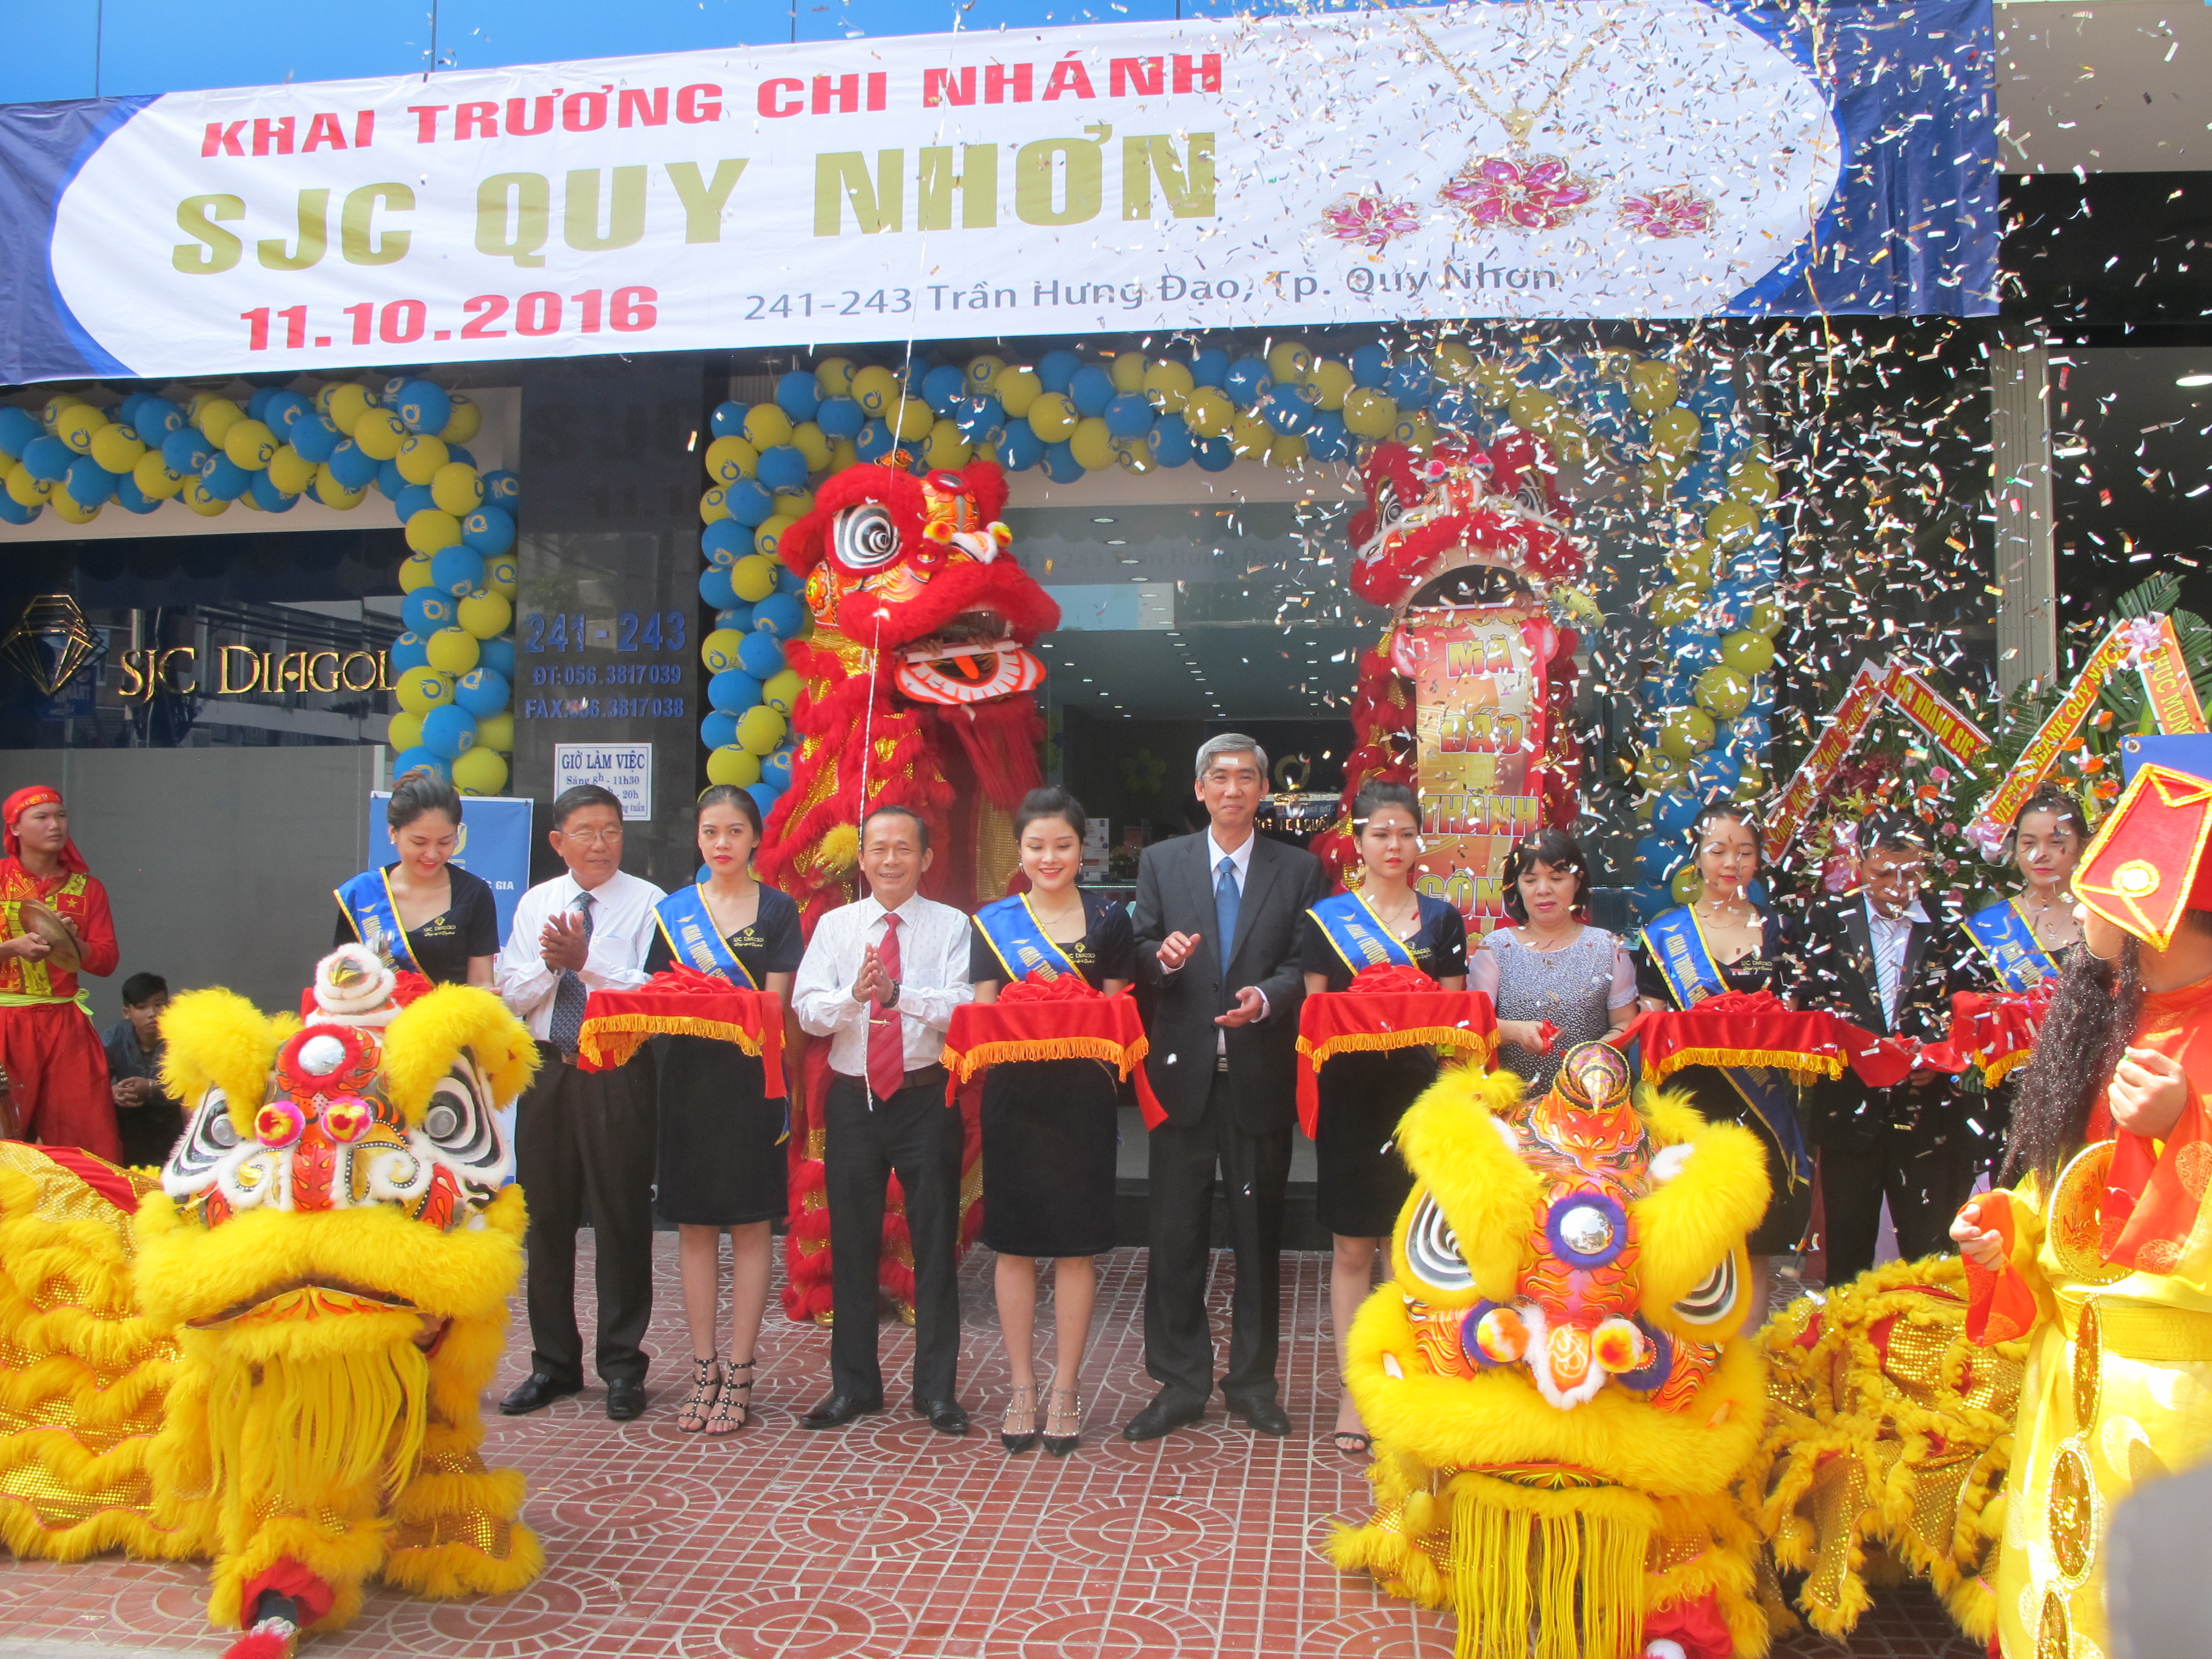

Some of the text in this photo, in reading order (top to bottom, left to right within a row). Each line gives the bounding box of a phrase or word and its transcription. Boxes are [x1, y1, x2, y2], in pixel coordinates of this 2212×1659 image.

[201, 50, 1221, 158] KHAI TRƯƠNG CHI NHÁNH
[172, 124, 1215, 275] SJC QUY NHƠN
[240, 286, 658, 351] 11.10.2016
[744, 287, 912, 321] 241-243
[927, 281, 1017, 312] Trần
[1032, 280, 1142, 310] Hưng
[1156, 275, 1253, 306] Đạo,
[1267, 270, 1331, 303] Tp.
[1346, 267, 1429, 297] Quy
[525, 612, 586, 653] 241
[617, 611, 686, 651] 243
[1446, 634, 1515, 679] MÃ
[118, 646, 197, 702] SJC
[1438, 707, 1523, 755] ĐÁO
[1991, 713, 2071, 824] VIETCOMBANK
[2065, 680, 2093, 720] QUY
[561, 750, 645, 773] GIỜ LÀM VIỆC
[566, 776, 590, 785] Sáng
[613, 776, 640, 785] 11h30
[623, 789, 639, 799] 20h
[1419, 786, 1539, 837] THÀNH
[495, 880, 515, 891] GIA
